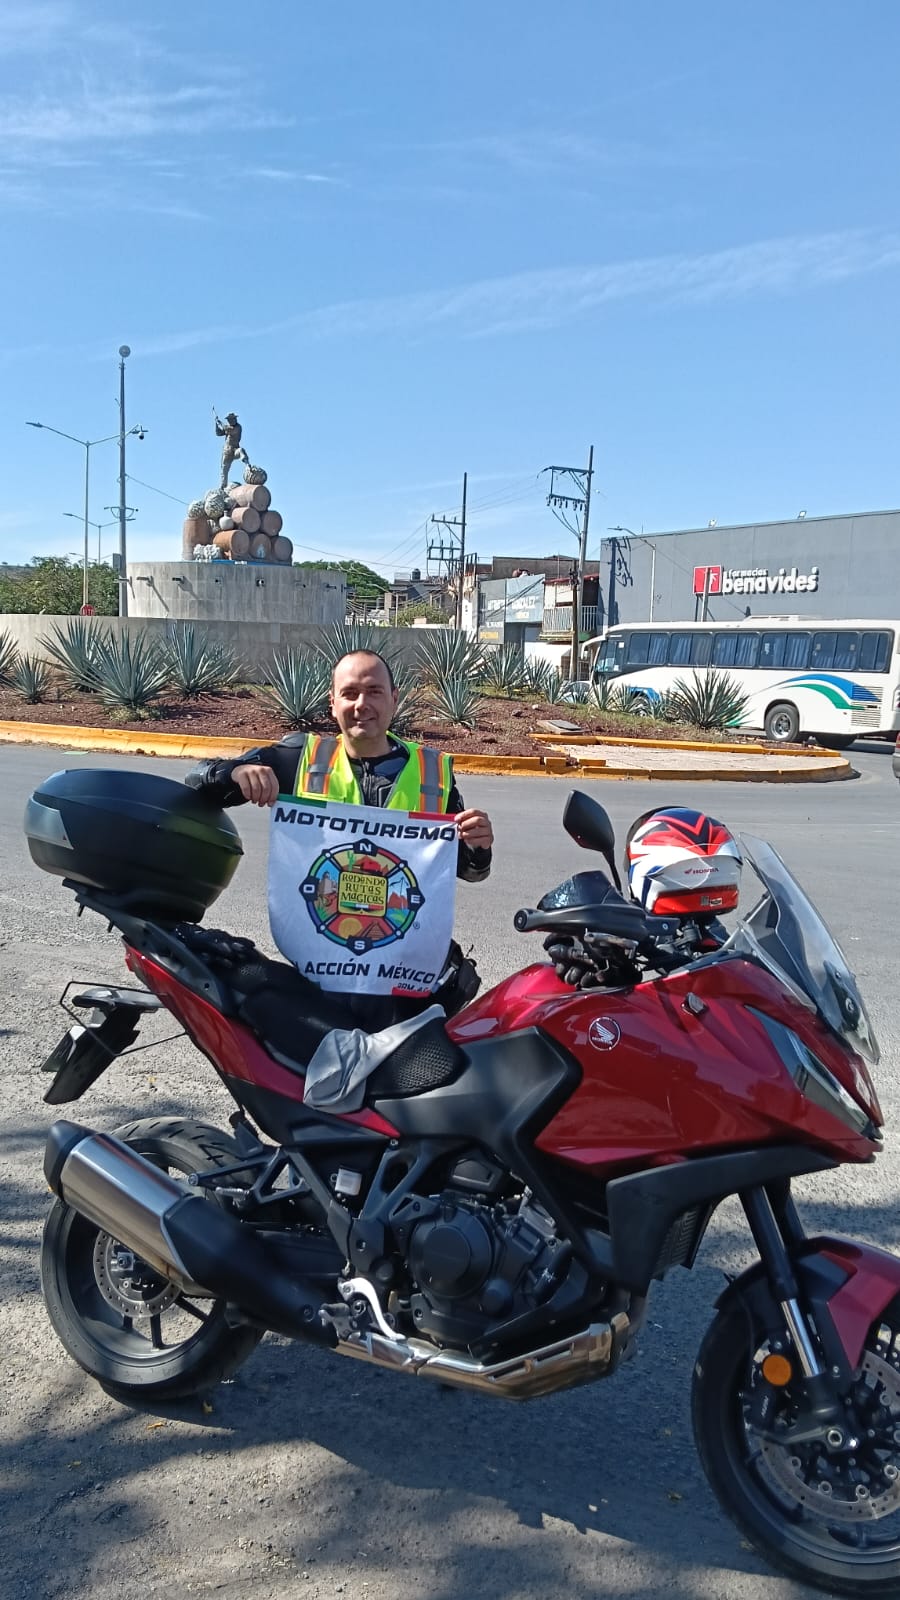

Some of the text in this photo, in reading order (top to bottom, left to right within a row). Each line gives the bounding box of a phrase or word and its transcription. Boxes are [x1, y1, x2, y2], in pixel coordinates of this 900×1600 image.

[722, 567, 819, 594] benavides
[274, 807, 456, 841] MOTOTURISMO
[359, 843, 372, 852] N
[303, 884, 315, 894] O
[410, 894, 421, 904] E
[354, 940, 365, 950] S
[304, 958, 435, 983] ACCIÓN MÉXICO
